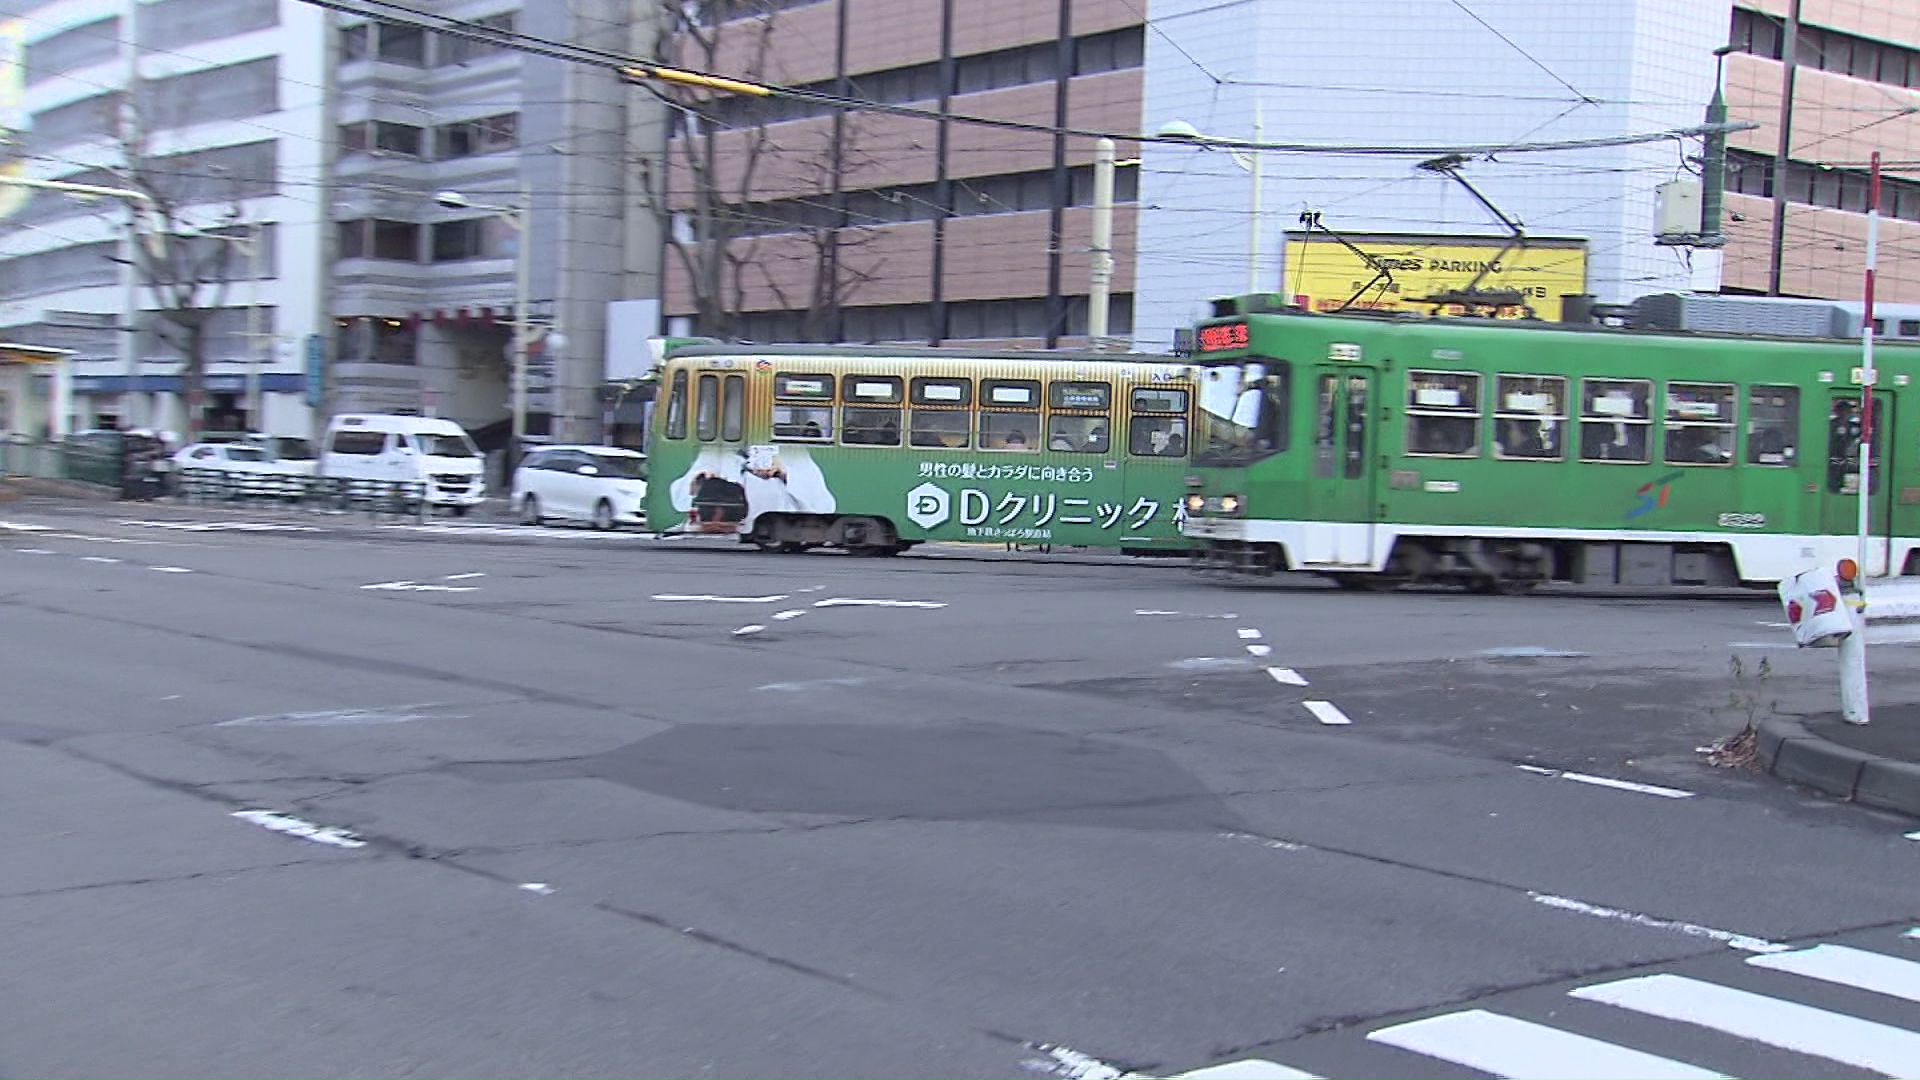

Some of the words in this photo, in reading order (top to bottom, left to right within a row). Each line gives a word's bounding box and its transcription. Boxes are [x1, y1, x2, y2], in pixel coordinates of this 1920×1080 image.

[1429, 260, 1502, 273] PARKING
[918, 462, 1094, 482] 男性の髪とカラダに向き合う
[959, 488, 1160, 530] Dクリニック
